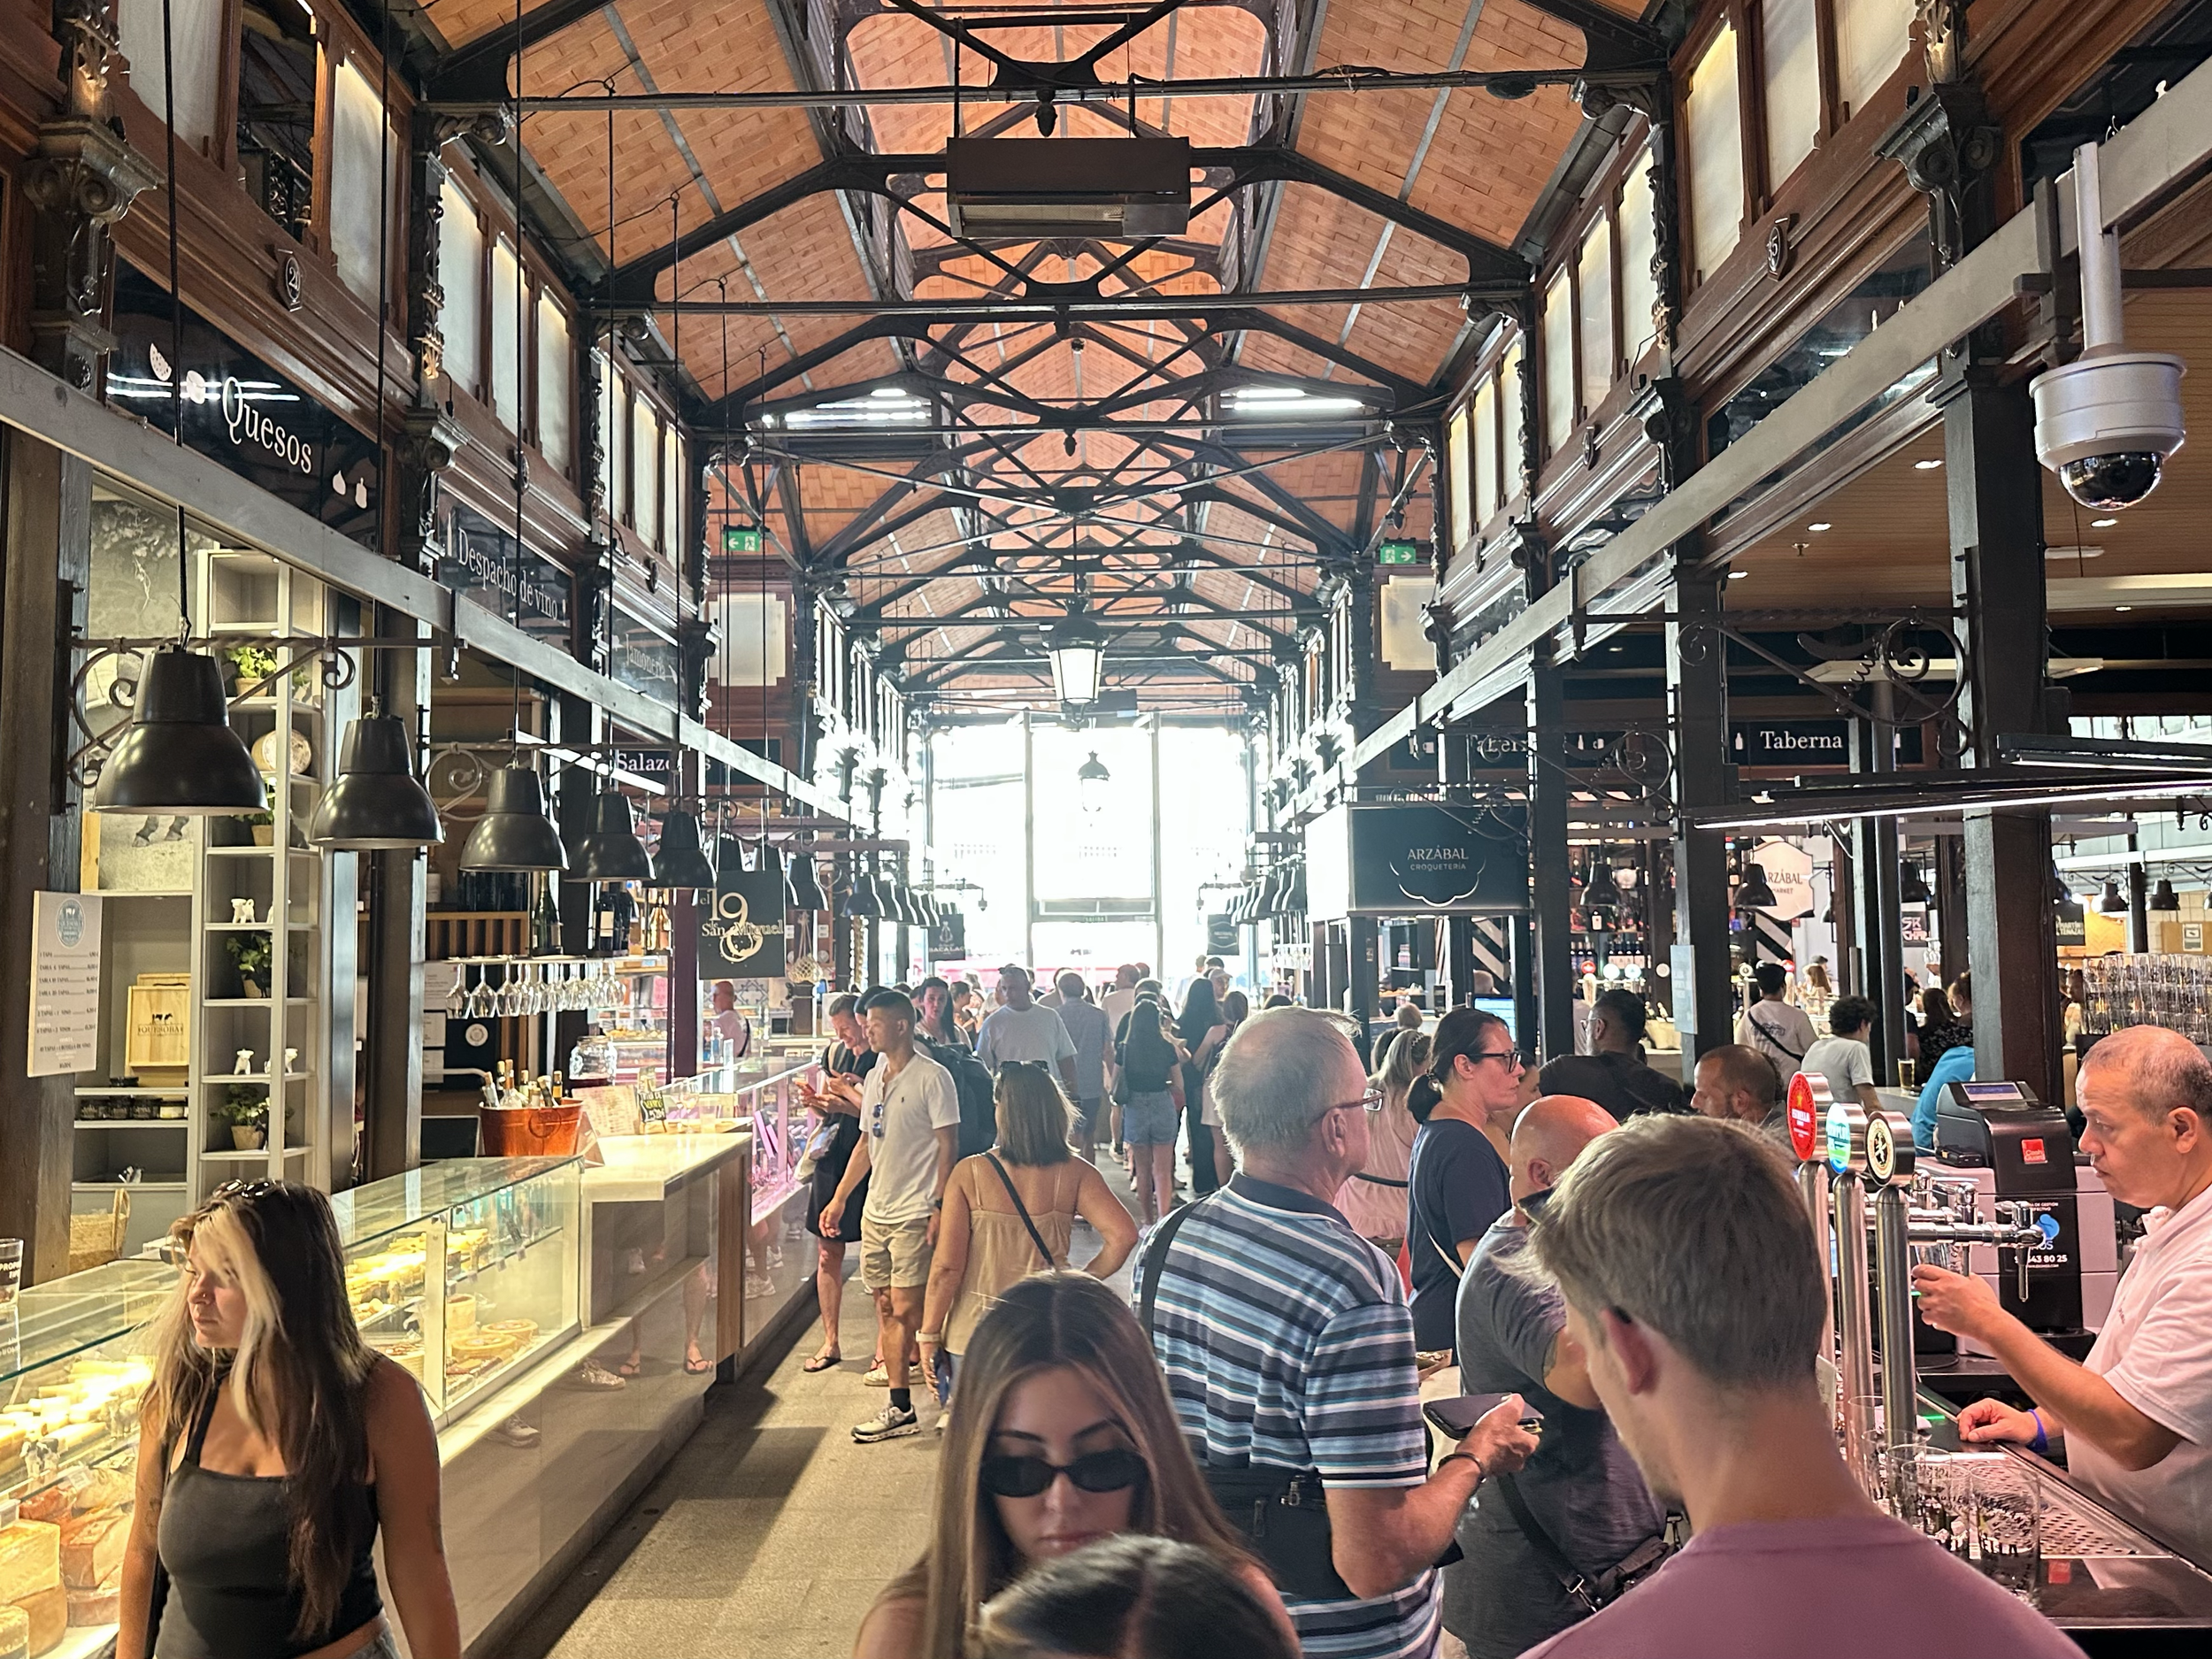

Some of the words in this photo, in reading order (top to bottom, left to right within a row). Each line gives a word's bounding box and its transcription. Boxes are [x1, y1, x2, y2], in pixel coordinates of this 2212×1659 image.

[222, 376, 311, 473] Quesos
[458, 526, 518, 596] Despacho
[519, 570, 534, 606] de
[534, 584, 557, 620] vino
[1760, 730, 1843, 749] Taberna
[1407, 844, 1469, 860] ARZÁBAL
[1409, 862, 1466, 872] CROQUETERÍA
[700, 893, 710, 904] el
[702, 922, 726, 937] San
[733, 919, 784, 941] Miguel
